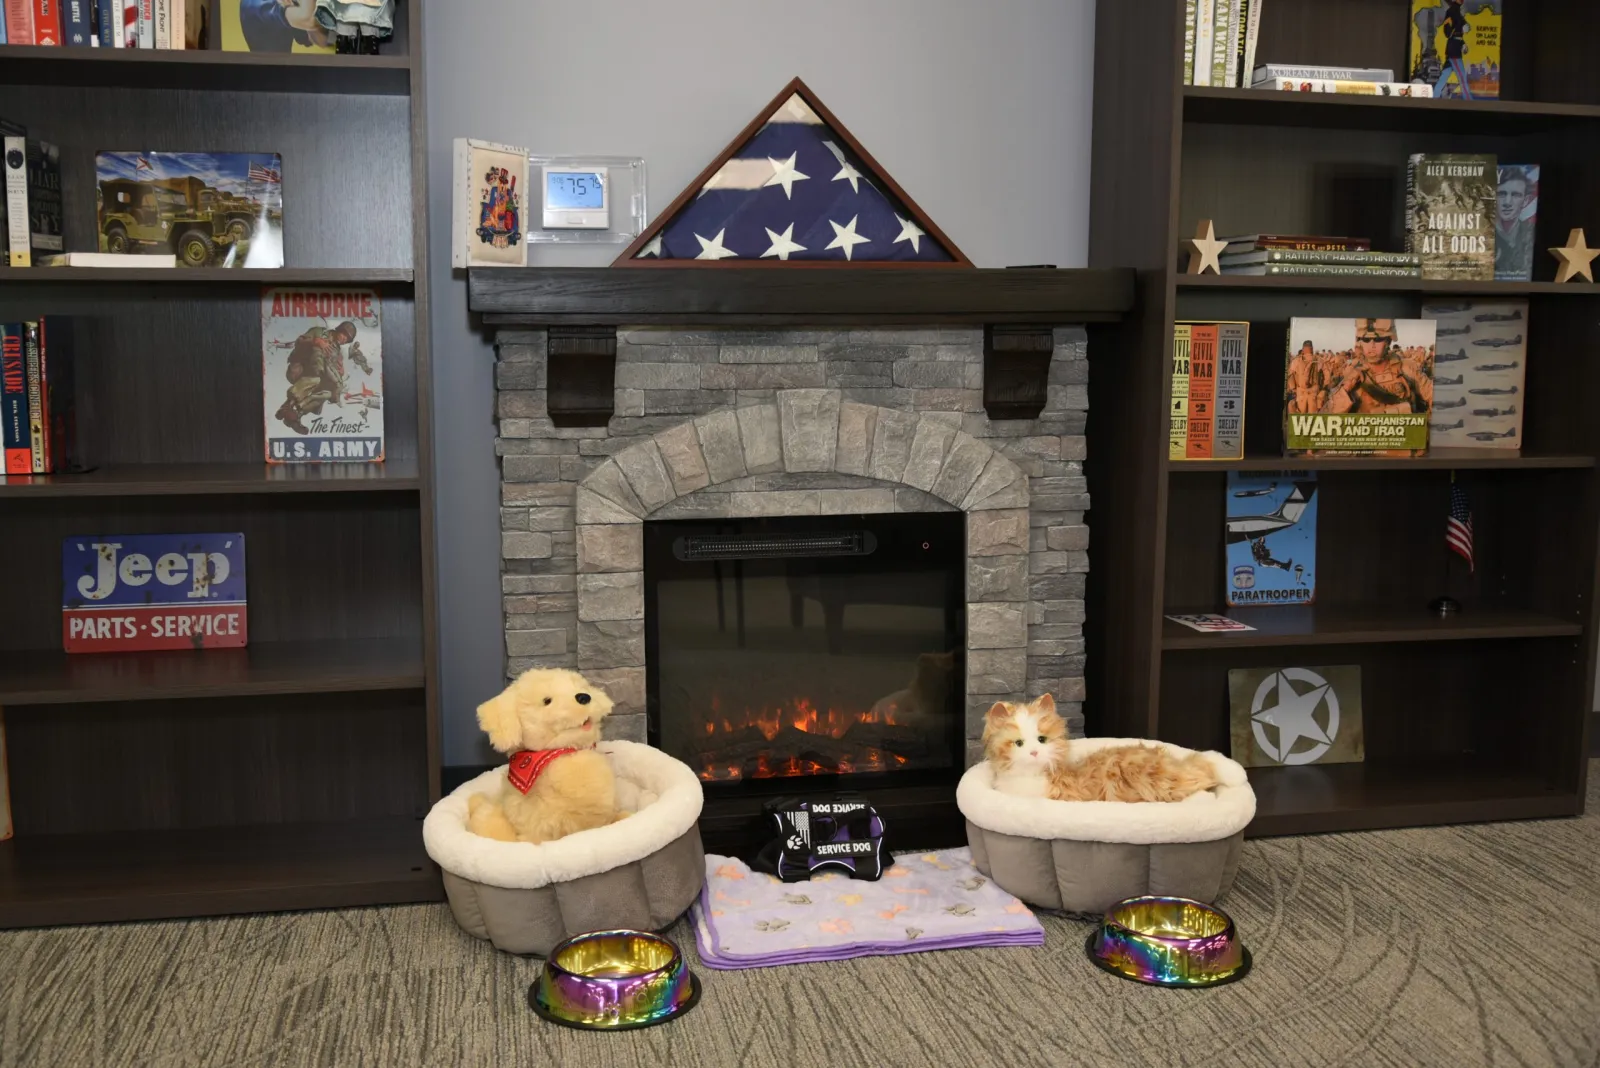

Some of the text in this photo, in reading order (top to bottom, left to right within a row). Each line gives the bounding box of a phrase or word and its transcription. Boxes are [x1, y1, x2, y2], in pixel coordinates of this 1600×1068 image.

[1184, 29, 1195, 63] WAR
[1213, 29, 1228, 64] WAR
[1271, 68, 1353, 81] KOREAN AIR WAR
[1426, 165, 1485, 177] ALEX KERSHAW
[567, 177, 586, 195] 75
[1428, 212, 1482, 230] AGAINST
[1295, 243, 1316, 251] VETS
[1422, 235, 1445, 254] ALL
[1451, 235, 1486, 254] ODDS
[1285, 251, 1410, 263] BATTLES CHANGED HISTORY
[271, 292, 373, 318] AIRBORNE
[1174, 339, 1190, 358] IVIL
[1193, 342, 1213, 360] CIVIL
[1221, 339, 1242, 358] CIVIL
[3, 335, 24, 394] CRUSADE
[1192, 362, 1213, 378] WAR
[1221, 359, 1242, 375] WAR
[28, 385, 41, 421] CONFLICT
[1195, 403, 1206, 413] 2
[1223, 400, 1235, 410] 3
[309, 416, 328, 435] The
[1291, 415, 1343, 436] WAR
[1344, 417, 1425, 426] IN AFGHANISTAN
[1344, 426, 1405, 436] AND IRAQ
[273, 440, 378, 458] U.S. ARMY
[1231, 588, 1310, 601] PARATROOPER
[69, 613, 239, 639] PARTS SERVICE
[812, 804, 831, 813] DOG
[817, 842, 871, 854] SERVICE DOG
